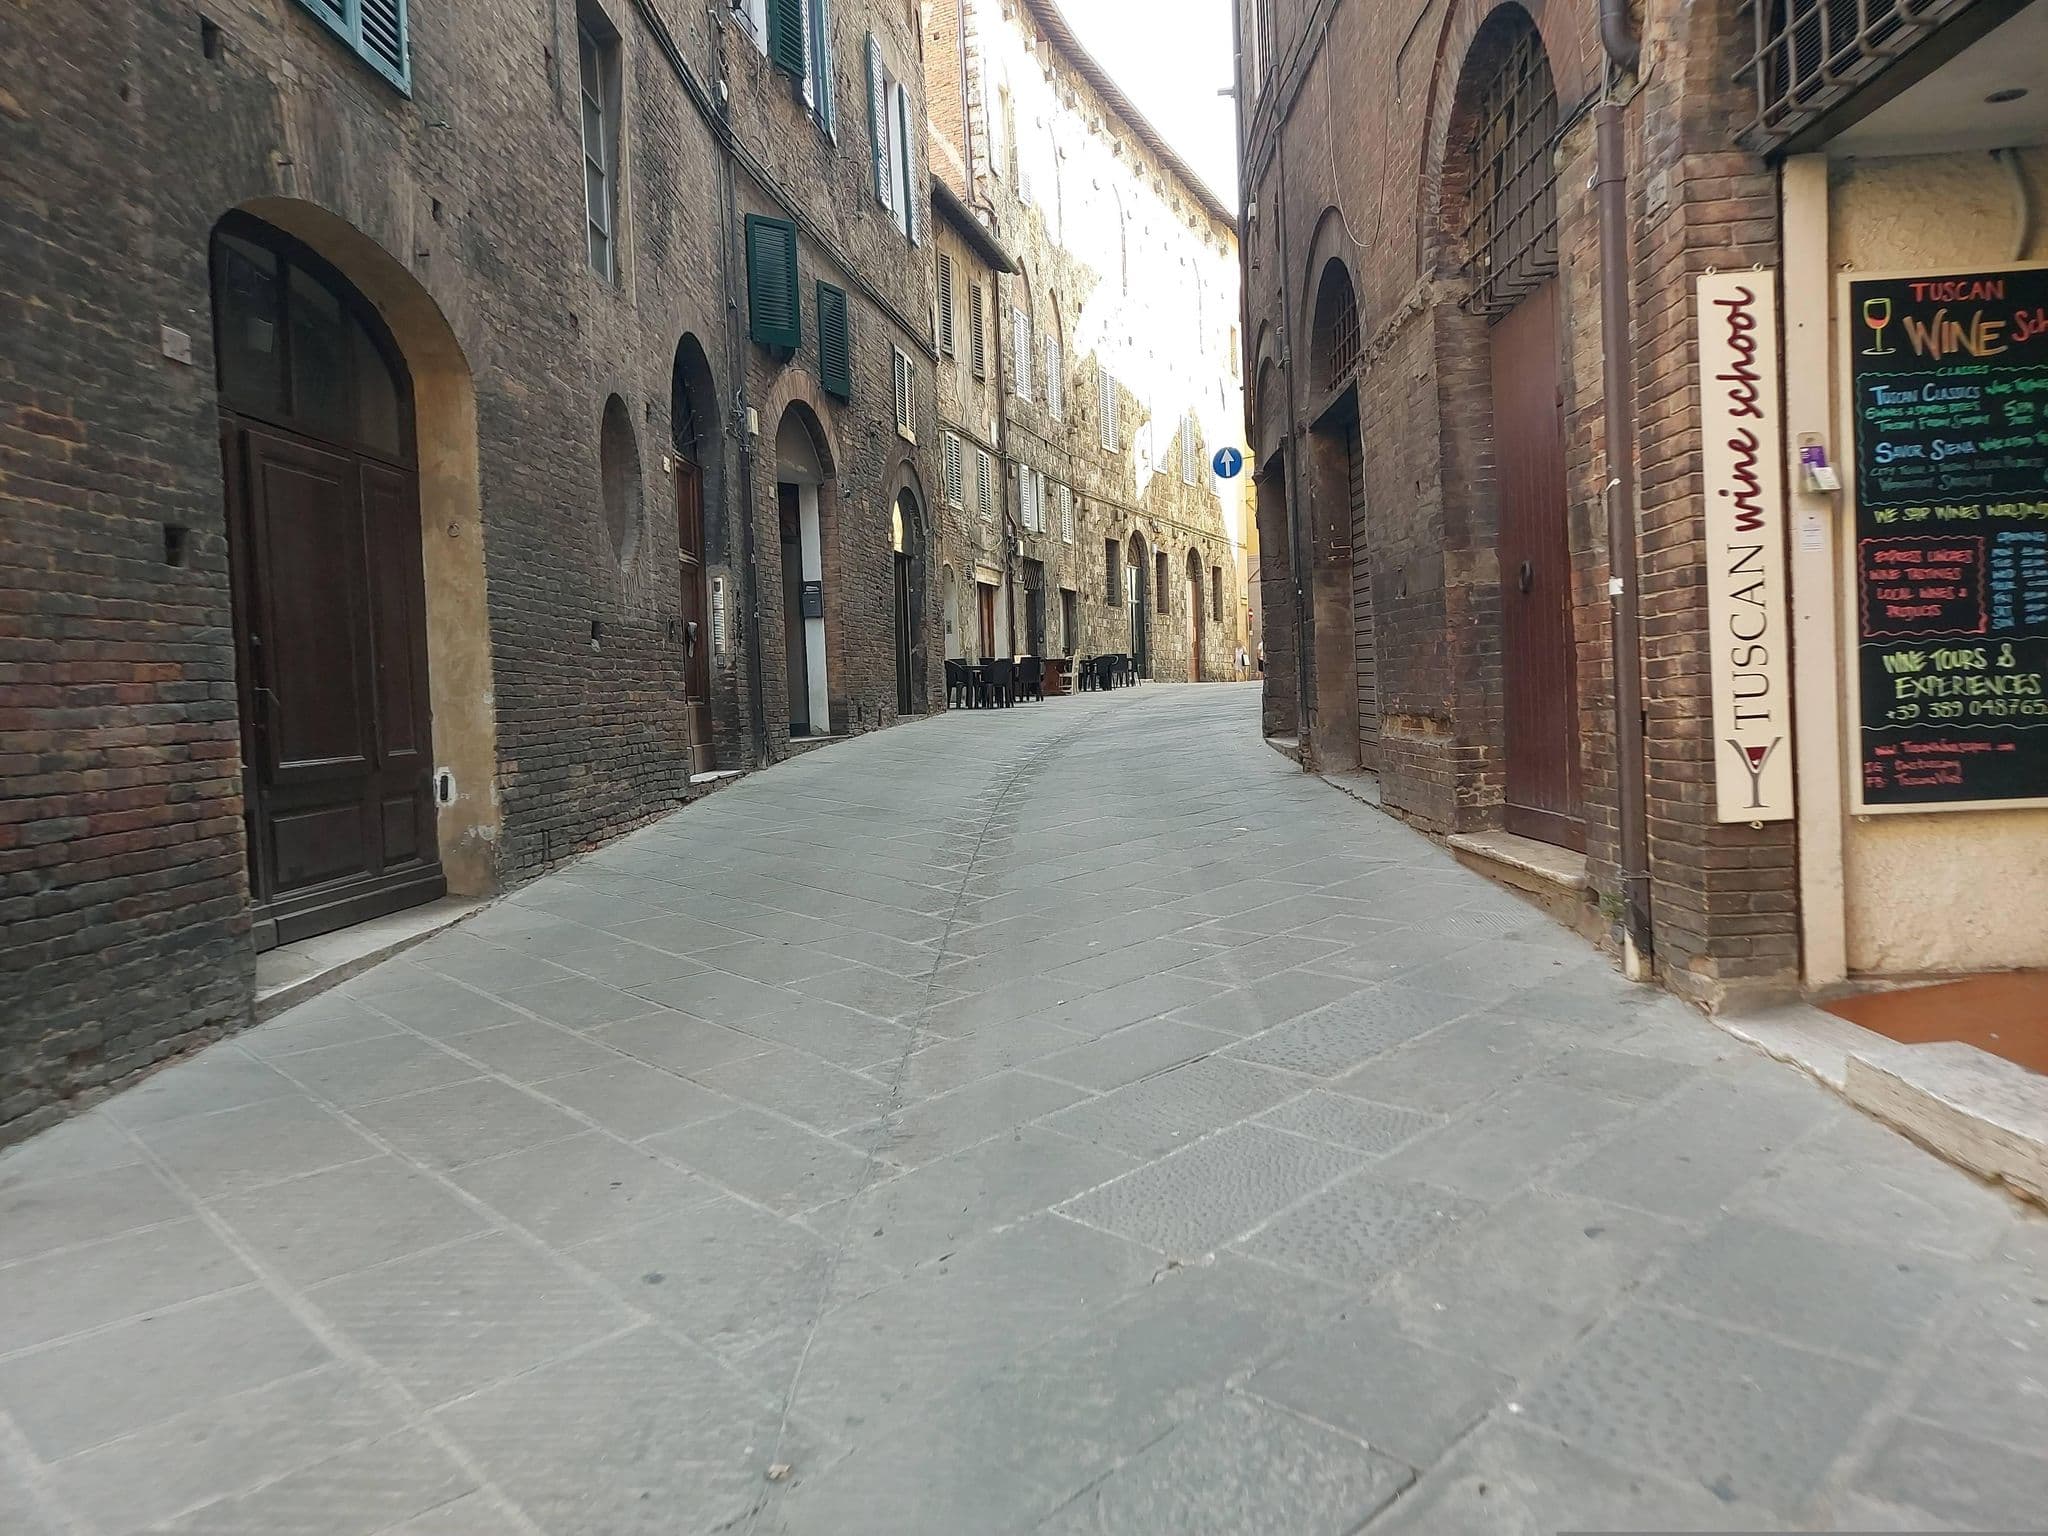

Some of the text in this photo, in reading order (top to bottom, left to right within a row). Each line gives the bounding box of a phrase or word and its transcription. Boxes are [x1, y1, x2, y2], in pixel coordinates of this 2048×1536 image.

[1908, 280, 2005, 302] TUSCAN
[1902, 308, 2008, 360] WINE
[1936, 365, 1990, 376] CLASSES
[1713, 286, 1771, 730] TUSCAN wine school
[1874, 507, 1898, 524] WE
[1934, 504, 1981, 521] WINES
[1882, 643, 2016, 673] WINE TOURS &
[1894, 673, 2042, 699] EXPERIENCES
